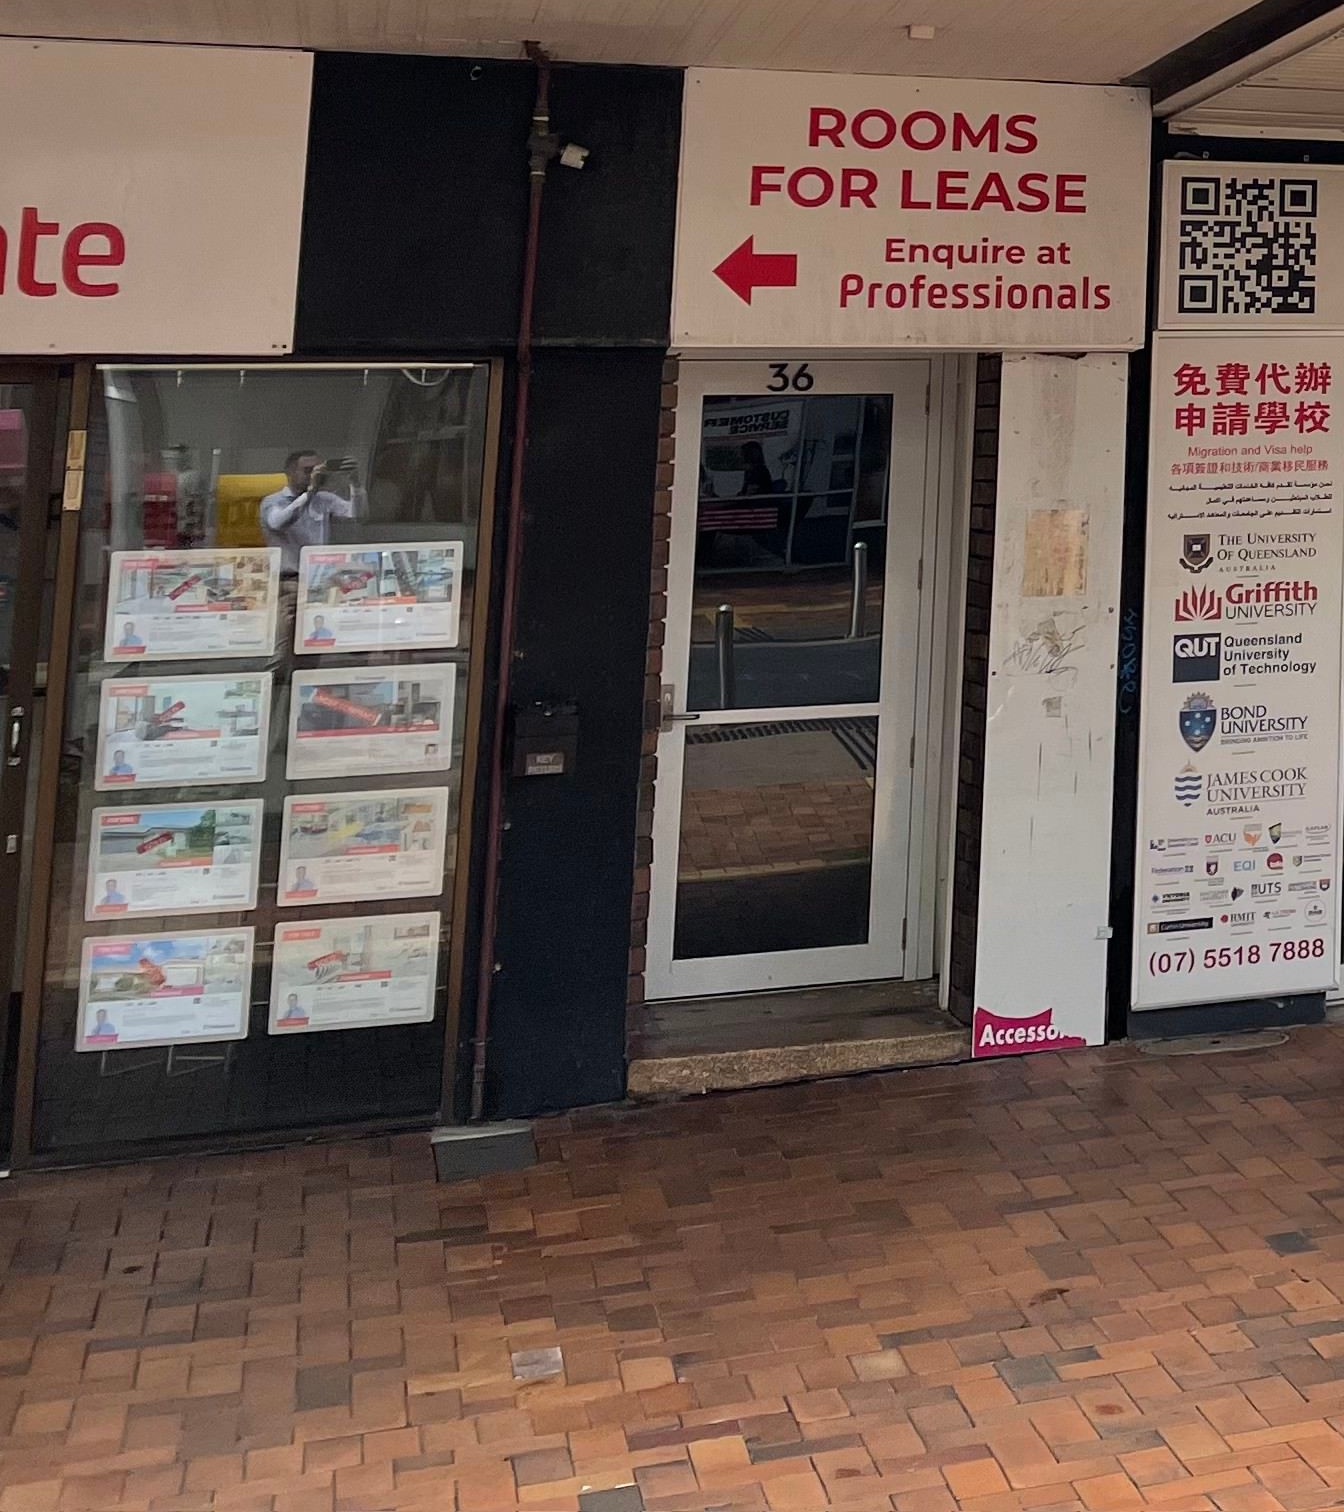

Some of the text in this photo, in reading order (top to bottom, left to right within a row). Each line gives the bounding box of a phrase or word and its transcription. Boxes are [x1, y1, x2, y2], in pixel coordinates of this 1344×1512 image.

[808, 107, 1039, 154] ROOMS
[750, 165, 1087, 214] FOR LEASE
[0, 207, 126, 298] te
[885, 237, 1071, 270] Enquire at
[839, 273, 1111, 310] Professionals
[766, 363, 815, 392] 36
[1173, 361, 1332, 397] 免費代辦
[1175, 400, 1331, 437] 申請學校
[1188, 444, 1313, 459] Migration and Visa help
[1218, 532, 1317, 546] THE UNIVERSITY
[1217, 547, 1317, 561] OF QUEENSLAND
[1225, 581, 1318, 604] Griffith
[1225, 603, 1318, 620] UNIVERSITY
[1175, 638, 1219, 658] QUT
[1224, 633, 1302, 648] Queensland
[1224, 648, 1290, 662] University
[1223, 660, 1316, 676] of Technology
[1221, 705, 1267, 720] BOND
[1221, 716, 1308, 734] UNIVERSITY
[1207, 767, 1307, 788] JAMES COOK
[1207, 783, 1307, 803] UNIVERSITY
[1206, 804, 1260, 816] AUSTRALIA
[1212, 833, 1237, 843] ACU
[1258, 882, 1282, 895] UTS
[1149, 938, 1325, 976] (07) 5518 7888
[979, 1024, 1065, 1047] Accesso
